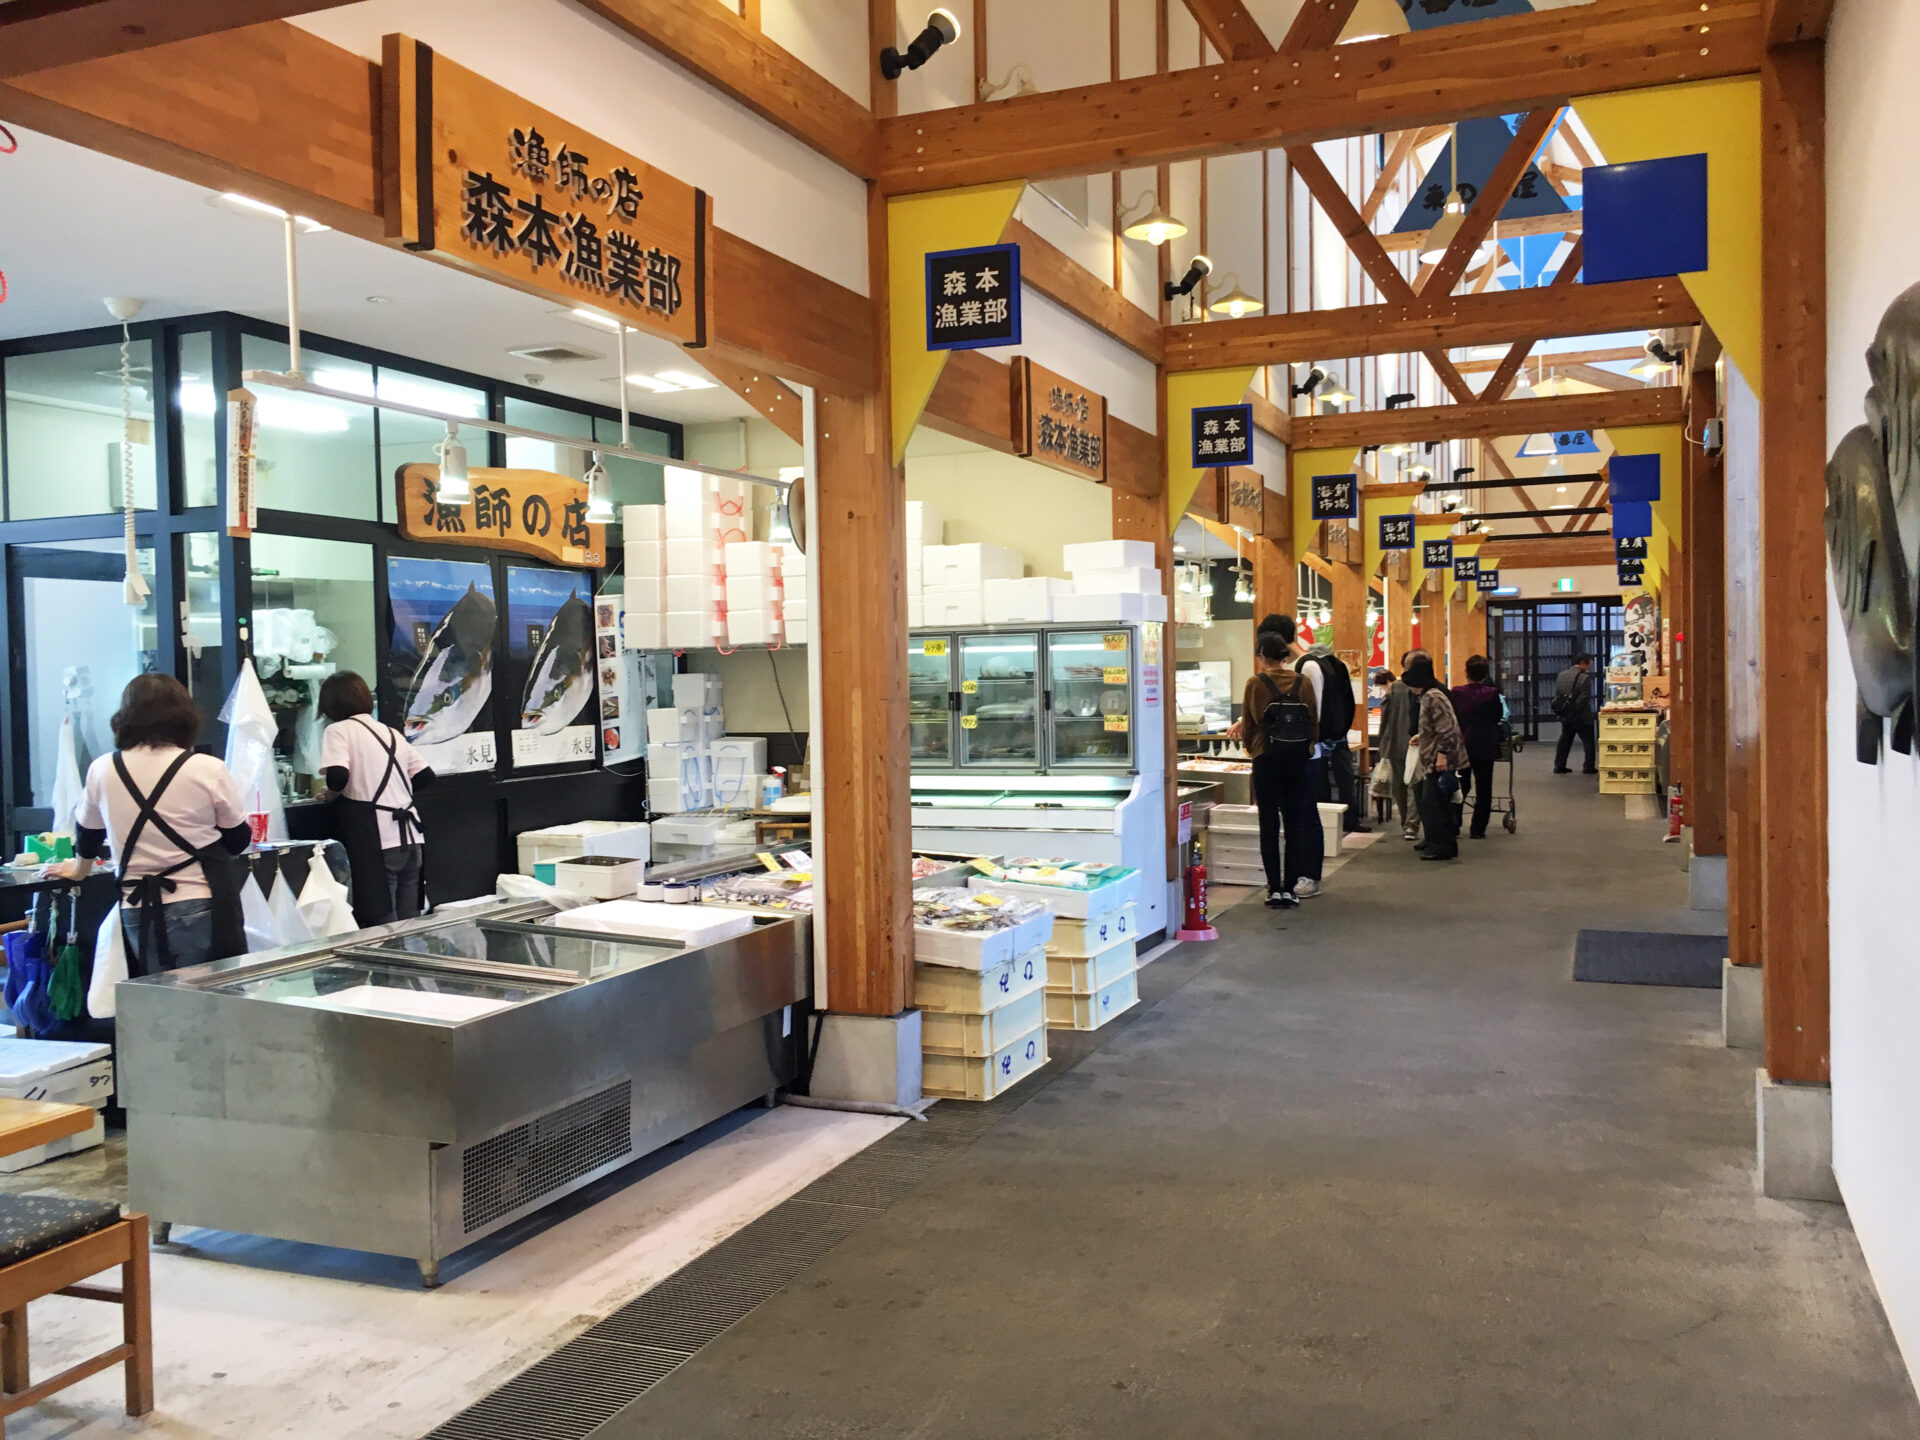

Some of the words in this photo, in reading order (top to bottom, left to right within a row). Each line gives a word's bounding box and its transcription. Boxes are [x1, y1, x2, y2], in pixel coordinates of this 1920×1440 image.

[509, 127, 643, 220] 漁師の店
[461, 171, 682, 315] 森本漁業部
[943, 267, 1000, 297] 森本
[934, 298, 1008, 329] 漁業部
[1203, 418, 1240, 435] 森本
[1038, 413, 1101, 469] 森本漁業部
[1198, 437, 1246, 455] 漁業部
[423, 478, 590, 548] 漁師の店
[1319, 498, 1350, 511] 市場
[1606, 717, 1649, 727] 魚河岸
[1606, 744, 1649, 753] 魚河岸
[1606, 770, 1649, 780] 魚河岸
